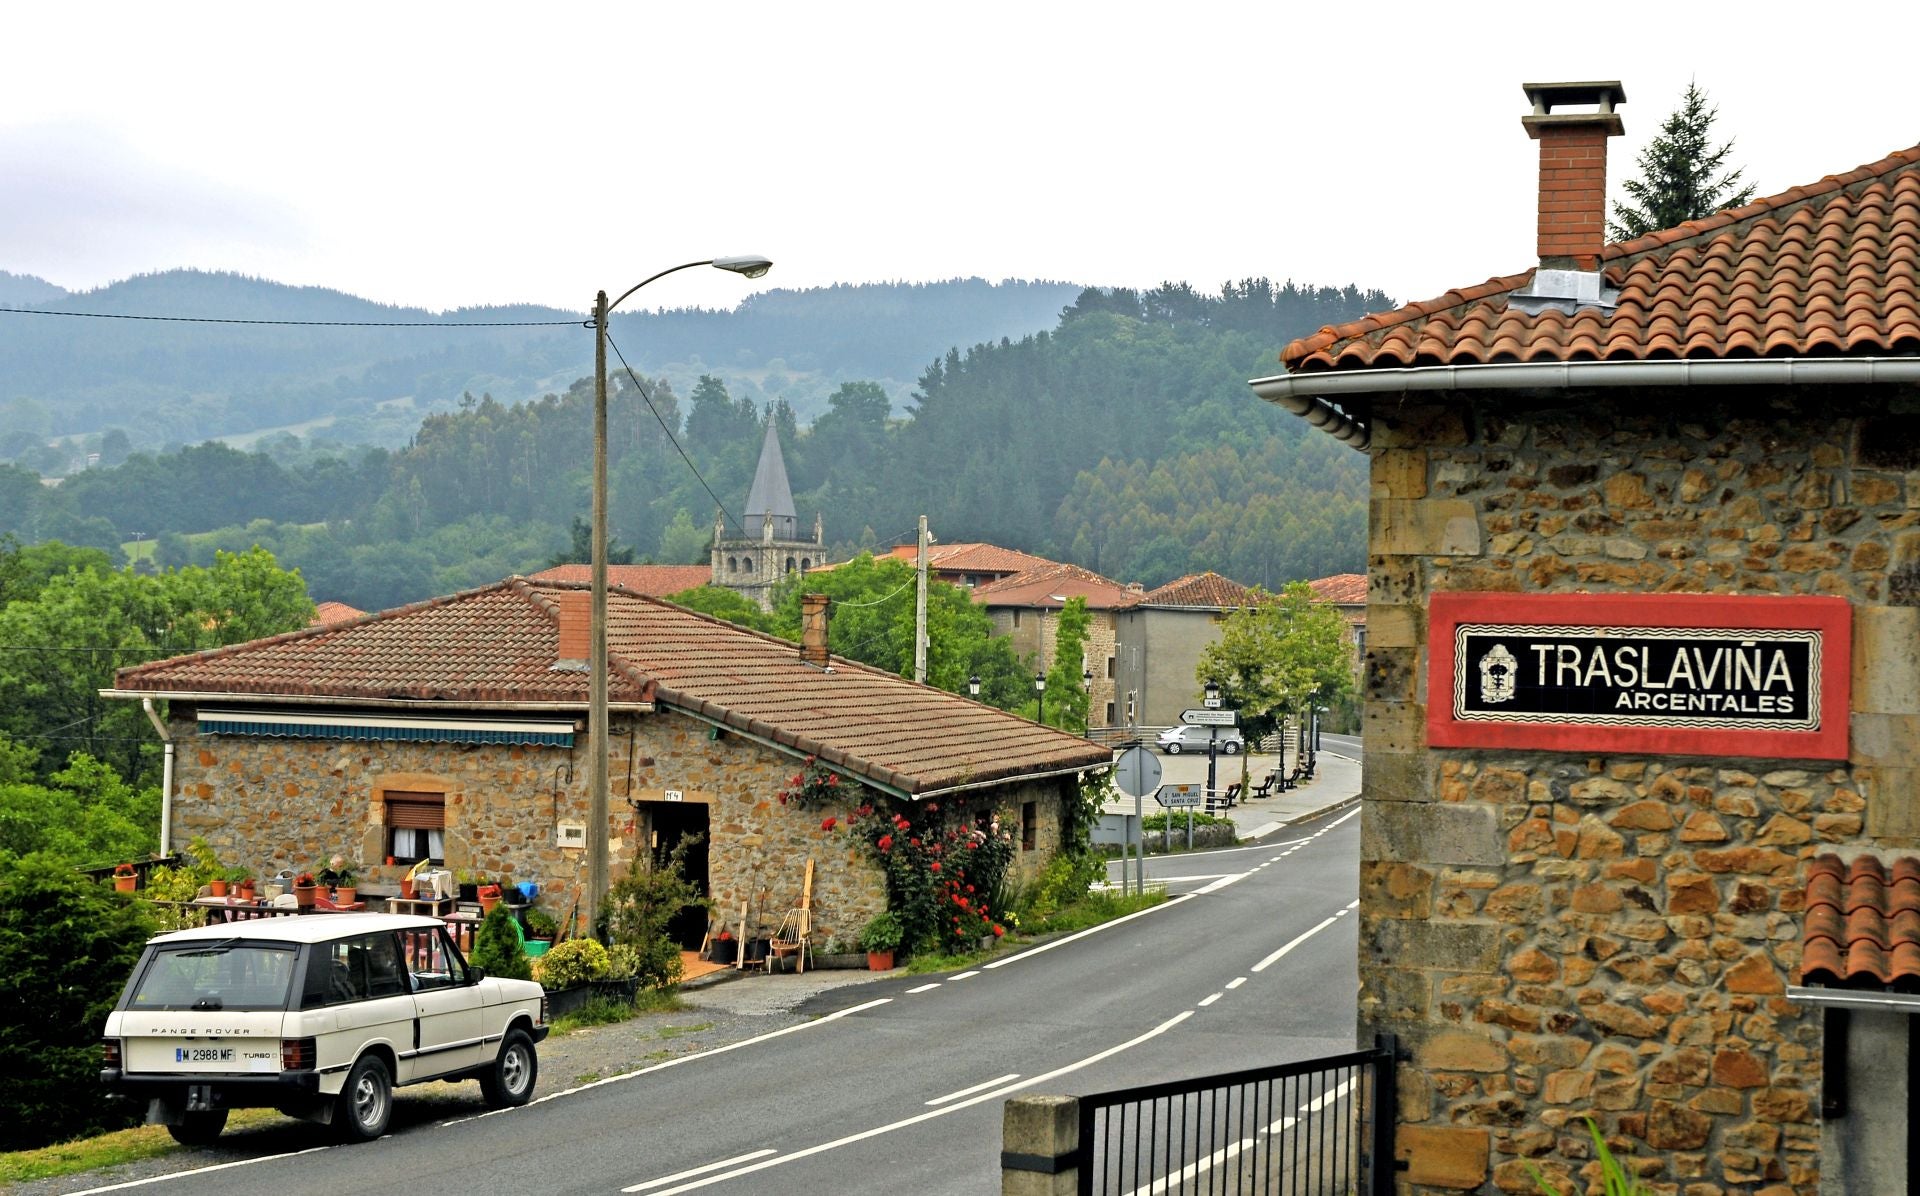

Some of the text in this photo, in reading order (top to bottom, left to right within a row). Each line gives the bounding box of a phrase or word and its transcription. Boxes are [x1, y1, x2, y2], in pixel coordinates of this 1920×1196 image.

[1530, 640, 1794, 692] TRASLAVIÑA
[1615, 691, 1794, 713] ARCENTALES
[183, 1049, 190, 1060] M
[193, 1049, 218, 1061] 2988
[220, 1049, 233, 1060] MF
